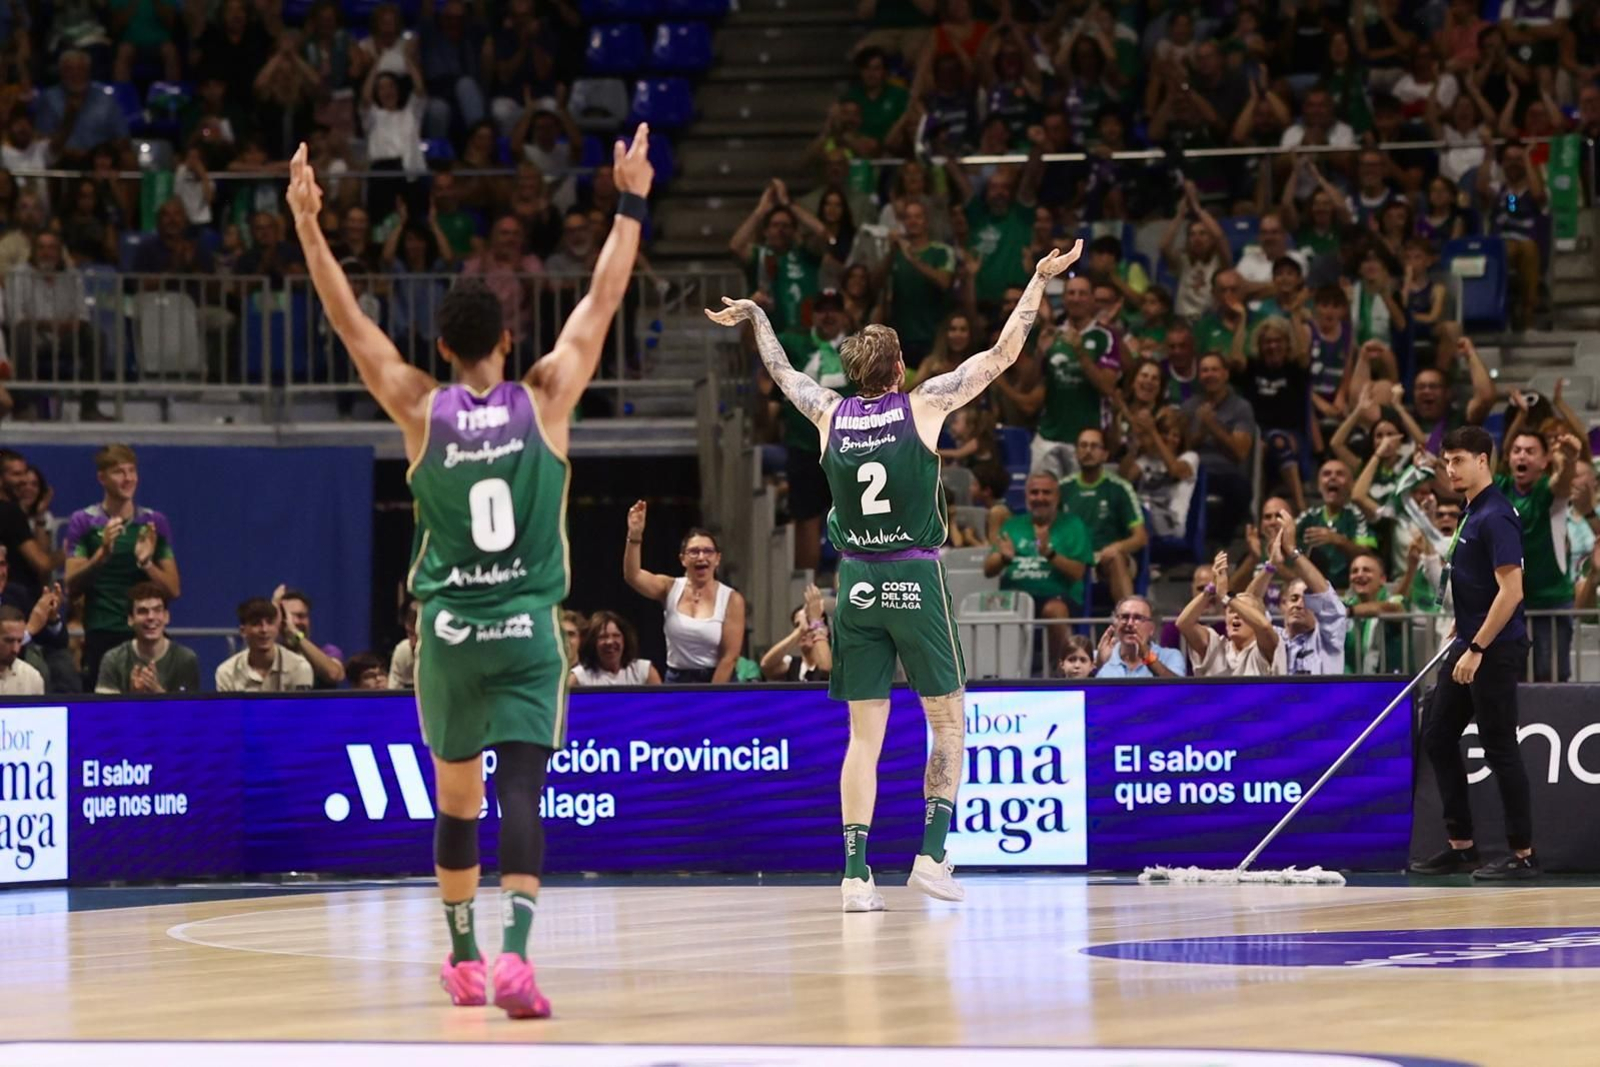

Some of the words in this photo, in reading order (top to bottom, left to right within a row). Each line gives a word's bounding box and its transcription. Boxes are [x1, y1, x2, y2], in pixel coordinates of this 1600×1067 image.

[856, 461, 892, 516] 2
[469, 477, 516, 552] 0
[881, 582, 921, 592] COSTA
[881, 592, 901, 601] DEL
[902, 592, 921, 601] SOL
[1, 719, 34, 751] bor
[965, 704, 1027, 735] bor
[629, 739, 789, 773] Provincial
[1114, 745, 1141, 772] El
[1149, 744, 1237, 772] sabor
[82, 760, 100, 787] El
[102, 759, 153, 786] sabor
[82, 796, 117, 825] que
[118, 795, 152, 817] nos
[154, 793, 188, 815] une
[1114, 782, 1172, 811] que
[1179, 782, 1236, 804] nos
[1243, 781, 1302, 804] une
[0, 812, 56, 870] aga
